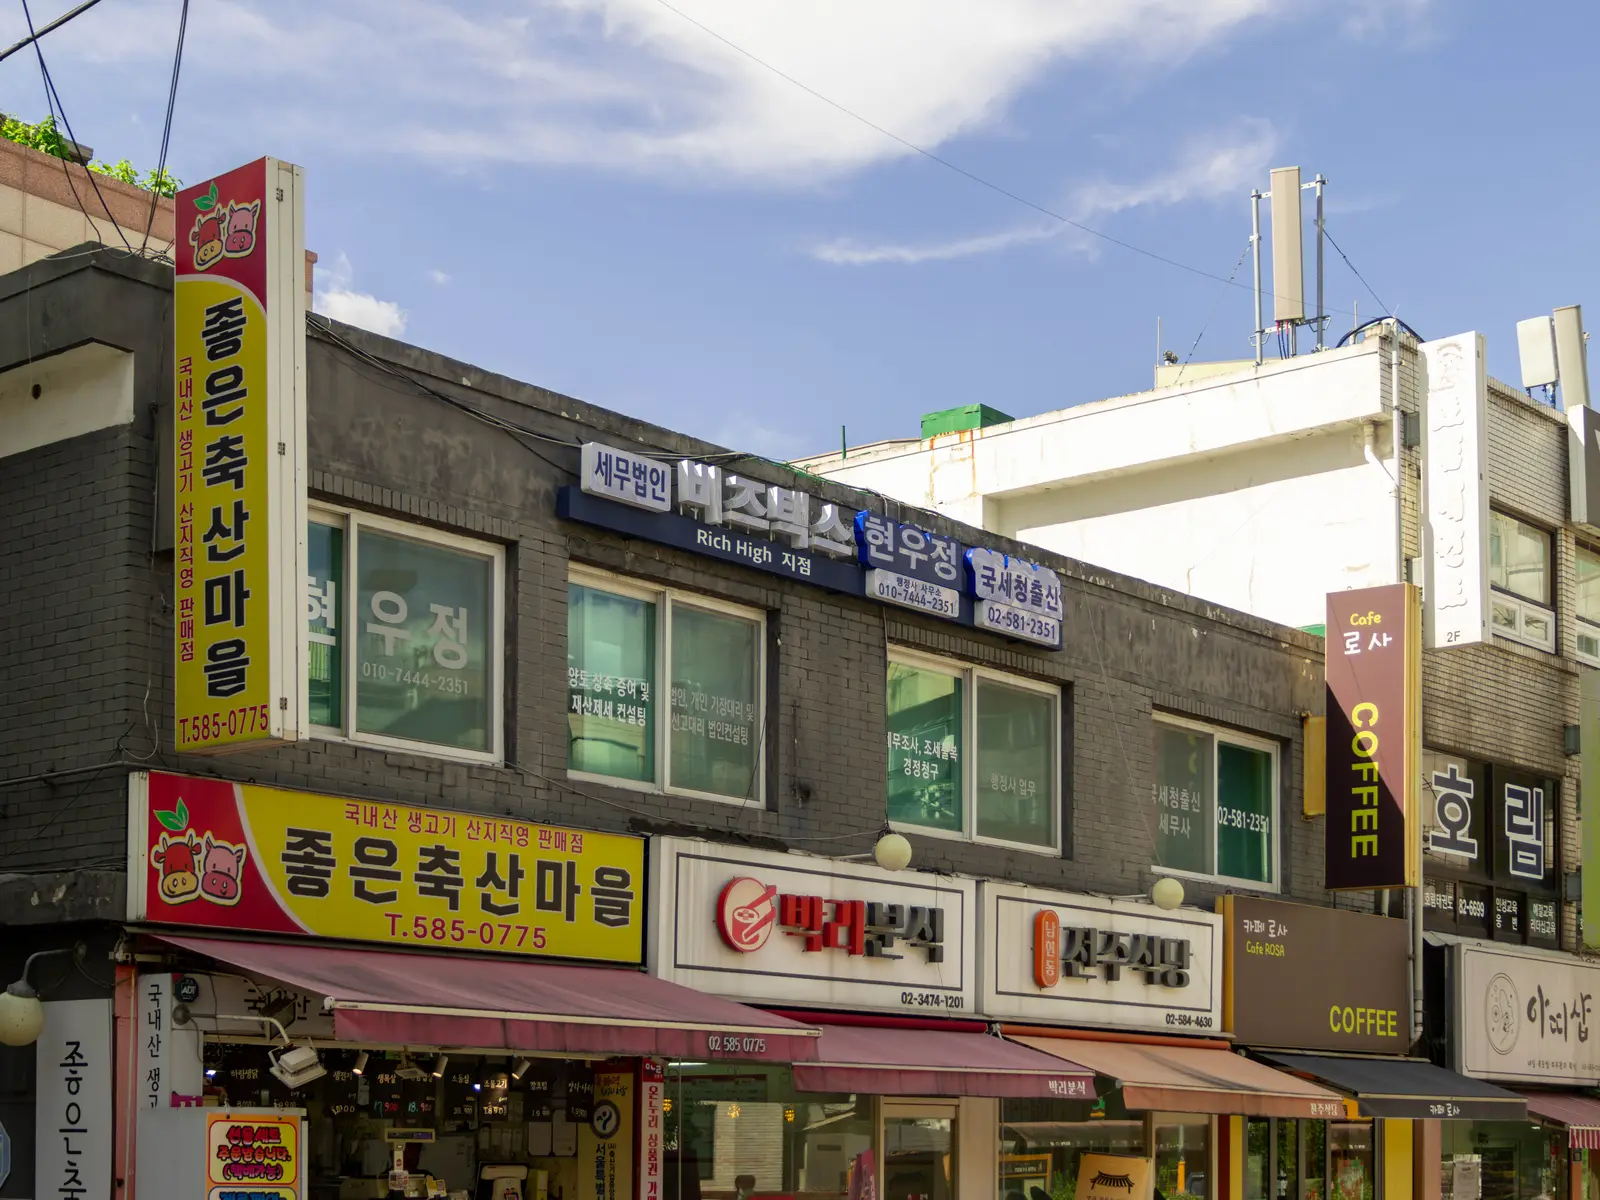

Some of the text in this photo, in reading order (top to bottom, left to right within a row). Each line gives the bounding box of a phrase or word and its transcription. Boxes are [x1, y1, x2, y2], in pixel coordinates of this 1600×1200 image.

[594, 450, 666, 503] 세무법인
[178, 356, 195, 662] 국내산 생고기 산지직영 판매점
[201, 296, 250, 698] 좋은축산마을
[696, 528, 812, 576] Rich High 지점
[865, 516, 957, 580] 현우정
[879, 583, 954, 614] 010-7444-2351
[921, 584, 942, 597] 사무소
[980, 564, 1060, 613] 국세청출신
[987, 606, 1056, 640] 02-581-2351
[1350, 610, 1382, 627] Cafe
[1447, 630, 1461, 643] 2F
[363, 662, 468, 695] 010-7444-2351
[616, 678, 636, 700] 증여
[640, 682, 650, 702] 및
[571, 694, 646, 727] 재산제세 컨설팅
[691, 691, 708, 712] 개인
[711, 695, 743, 720] 기장대리
[179, 704, 269, 745] T.585-0775
[671, 711, 749, 746] 신고대리 법인컨설팅
[903, 757, 939, 780] 경정청구
[1351, 702, 1379, 859] COFFEE
[1019, 778, 1037, 797] 업무
[345, 802, 584, 855] 국내산 생고기 산지직영 판매점
[1159, 813, 1191, 839] 세무사
[1218, 806, 1270, 833] 02-581-2351
[1429, 763, 1544, 880] 호림
[280, 826, 635, 928] 좋은축산마을
[384, 912, 548, 949] T.585-0775
[777, 893, 945, 964] 박리분식
[1243, 919, 1288, 938] 카페 로사
[1061, 927, 1194, 988] 전주식당
[1246, 940, 1285, 957] Cafe ROSA
[181, 984, 197, 995] ADT
[900, 991, 964, 1009] 02-3474-1201
[147, 984, 163, 1058] 국내산
[1165, 1013, 1213, 1028] 02-584-4630
[1329, 1005, 1398, 1037] COFFEE
[708, 1036, 766, 1053] 02 585 0775
[1048, 1080, 1086, 1096] 박리분식
[648, 1085, 659, 1129] 온누리
[226, 1125, 282, 1145] 선물세트
[216, 1144, 292, 1163] 주문받습니다.
[647, 1132, 659, 1177] 상품권
[222, 1162, 284, 1181] (택배가능)
